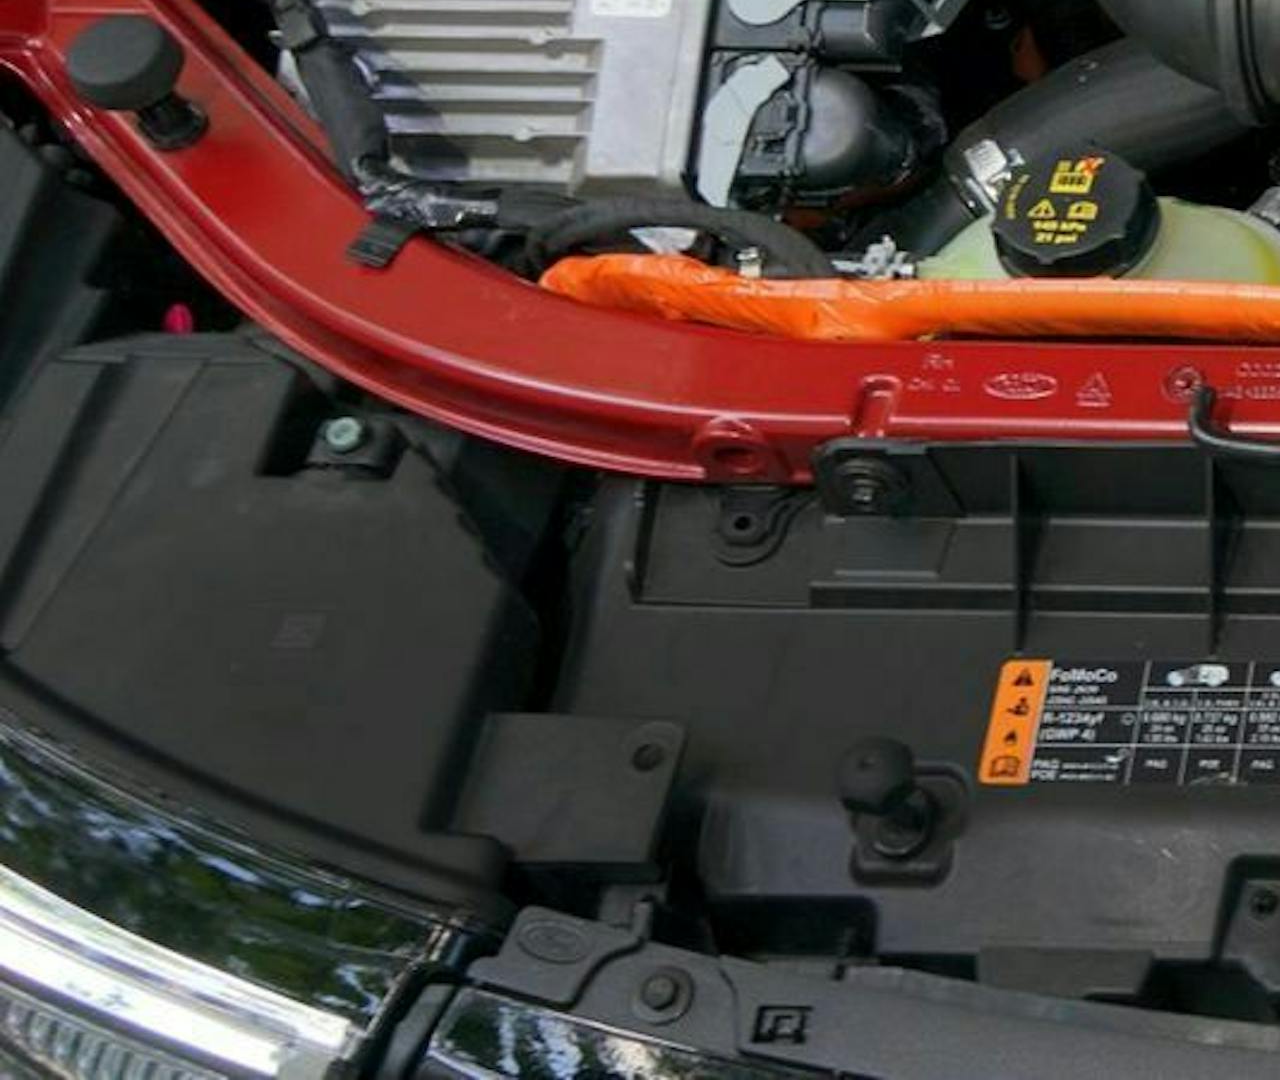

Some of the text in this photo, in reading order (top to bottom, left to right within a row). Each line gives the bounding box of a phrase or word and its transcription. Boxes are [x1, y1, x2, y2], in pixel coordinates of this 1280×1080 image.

[1060, 220, 1086, 232] kPa
[1036, 232, 1078, 244] 21 psi
[1050, 668, 1118, 683] FoMoCo
